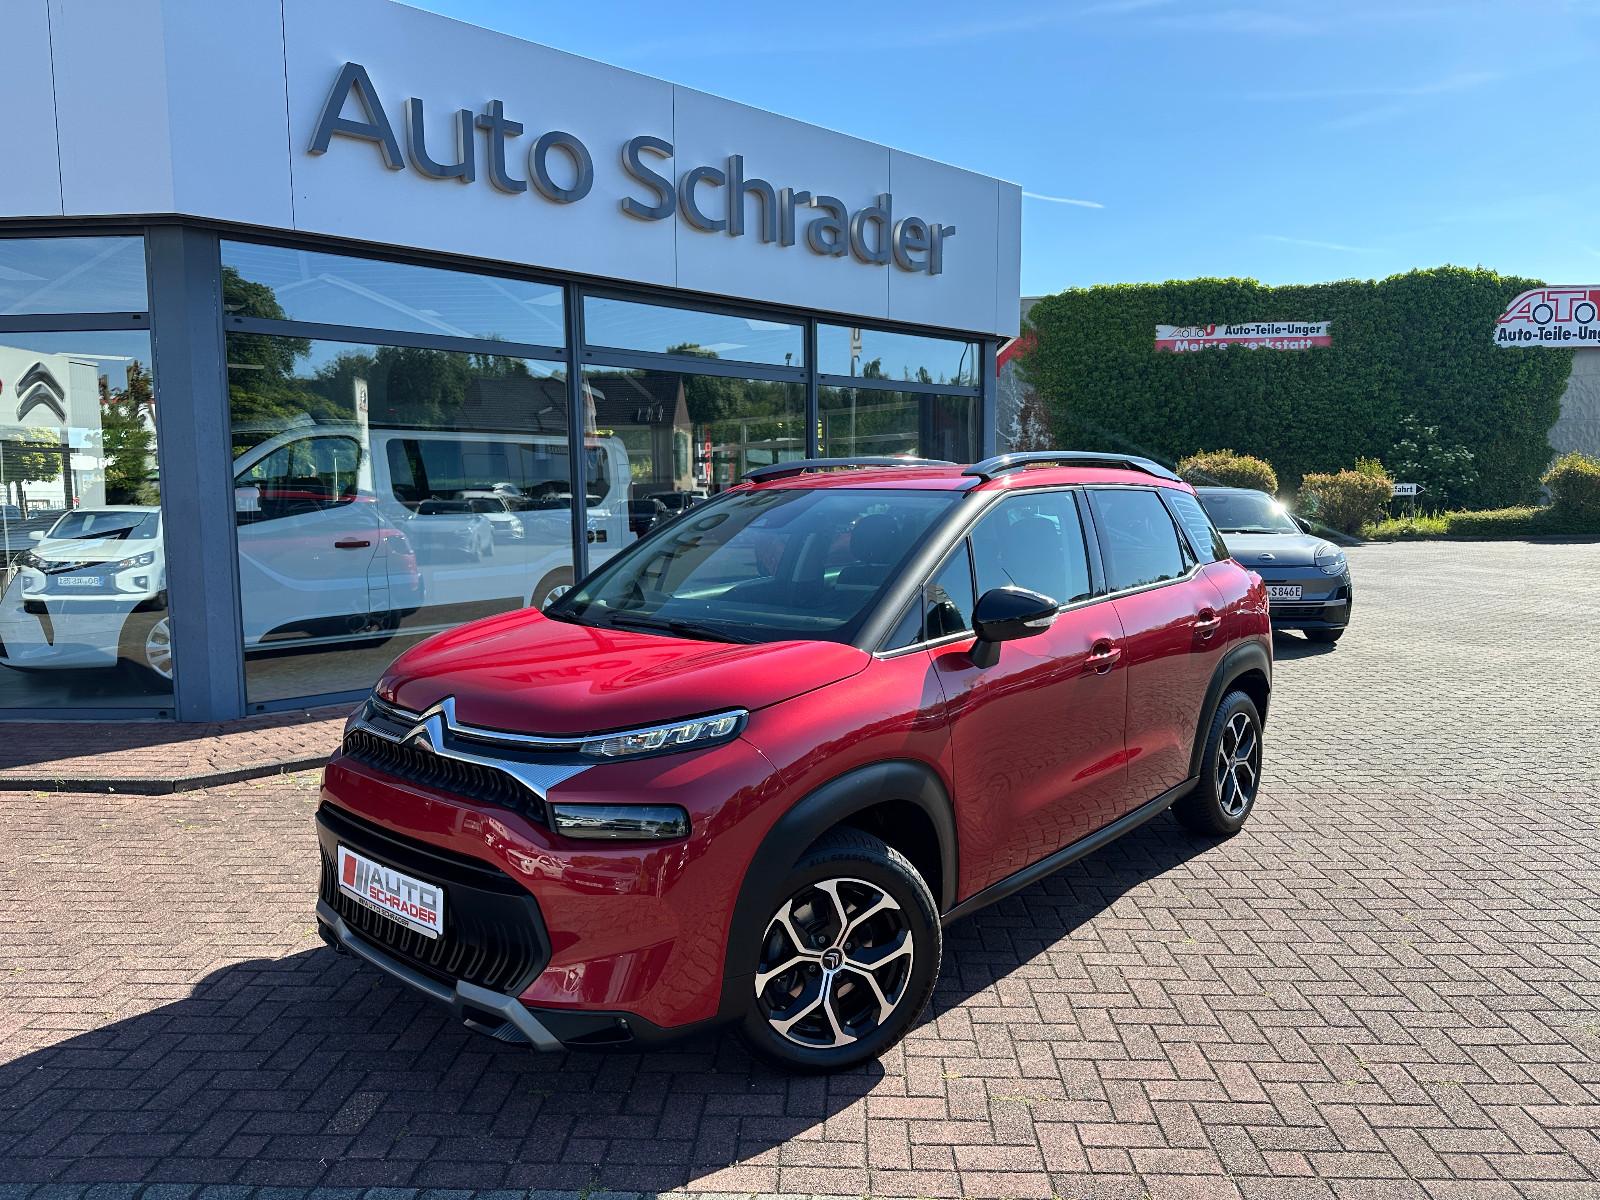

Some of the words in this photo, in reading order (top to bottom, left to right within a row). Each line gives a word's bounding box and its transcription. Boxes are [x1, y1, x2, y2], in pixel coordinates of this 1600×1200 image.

[307, 61, 594, 204] Auto
[621, 134, 956, 274] Schrader
[1224, 324, 1321, 336] Auto-Teile-Unger
[369, 867, 437, 912] AUTO
[369, 885, 437, 926] SCHRADER
